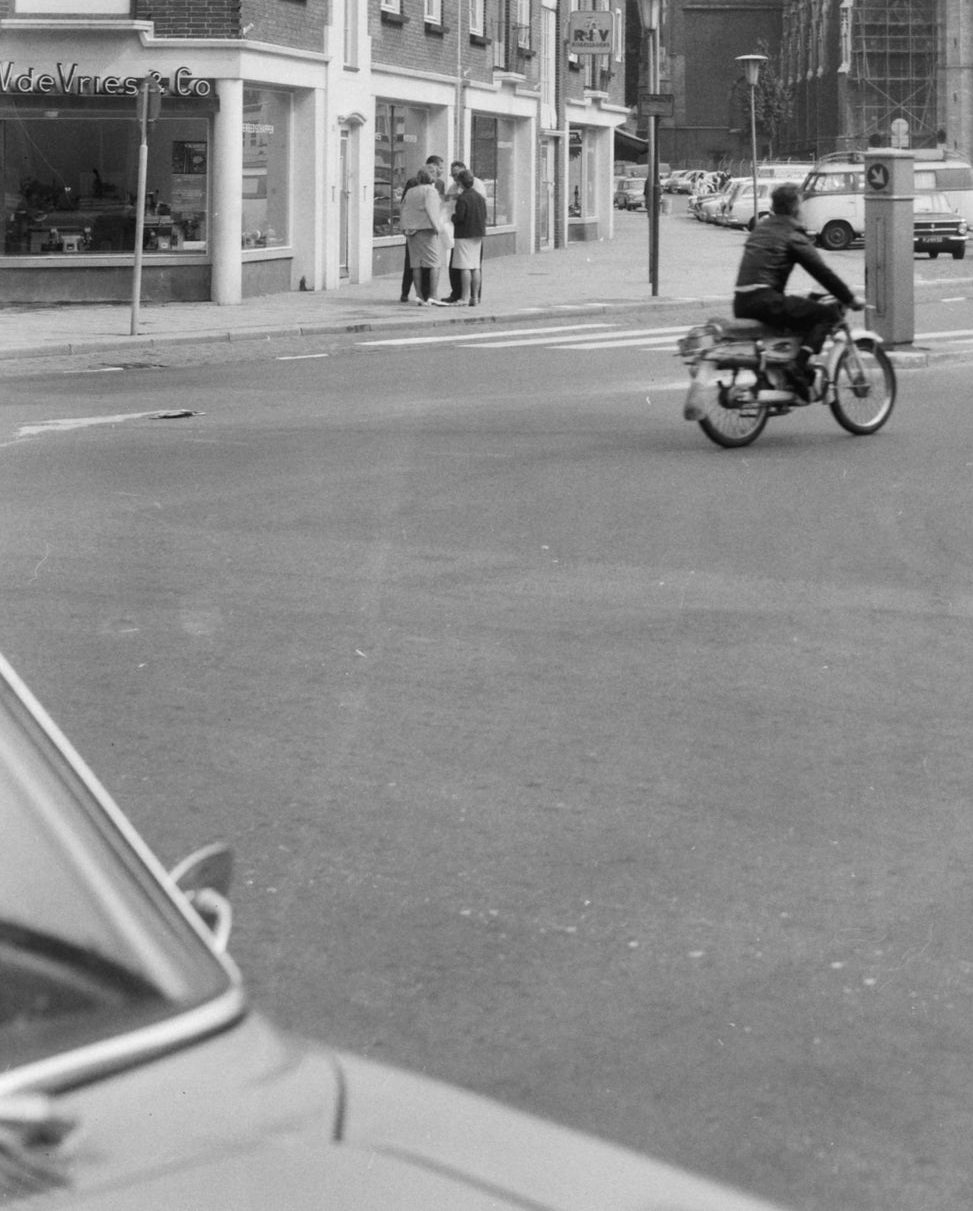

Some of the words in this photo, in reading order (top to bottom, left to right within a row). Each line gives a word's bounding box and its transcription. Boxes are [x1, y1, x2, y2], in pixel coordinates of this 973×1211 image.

[16, 67, 55, 93] de
[56, 63, 139, 96] Vries
[173, 66, 211, 98] Co
